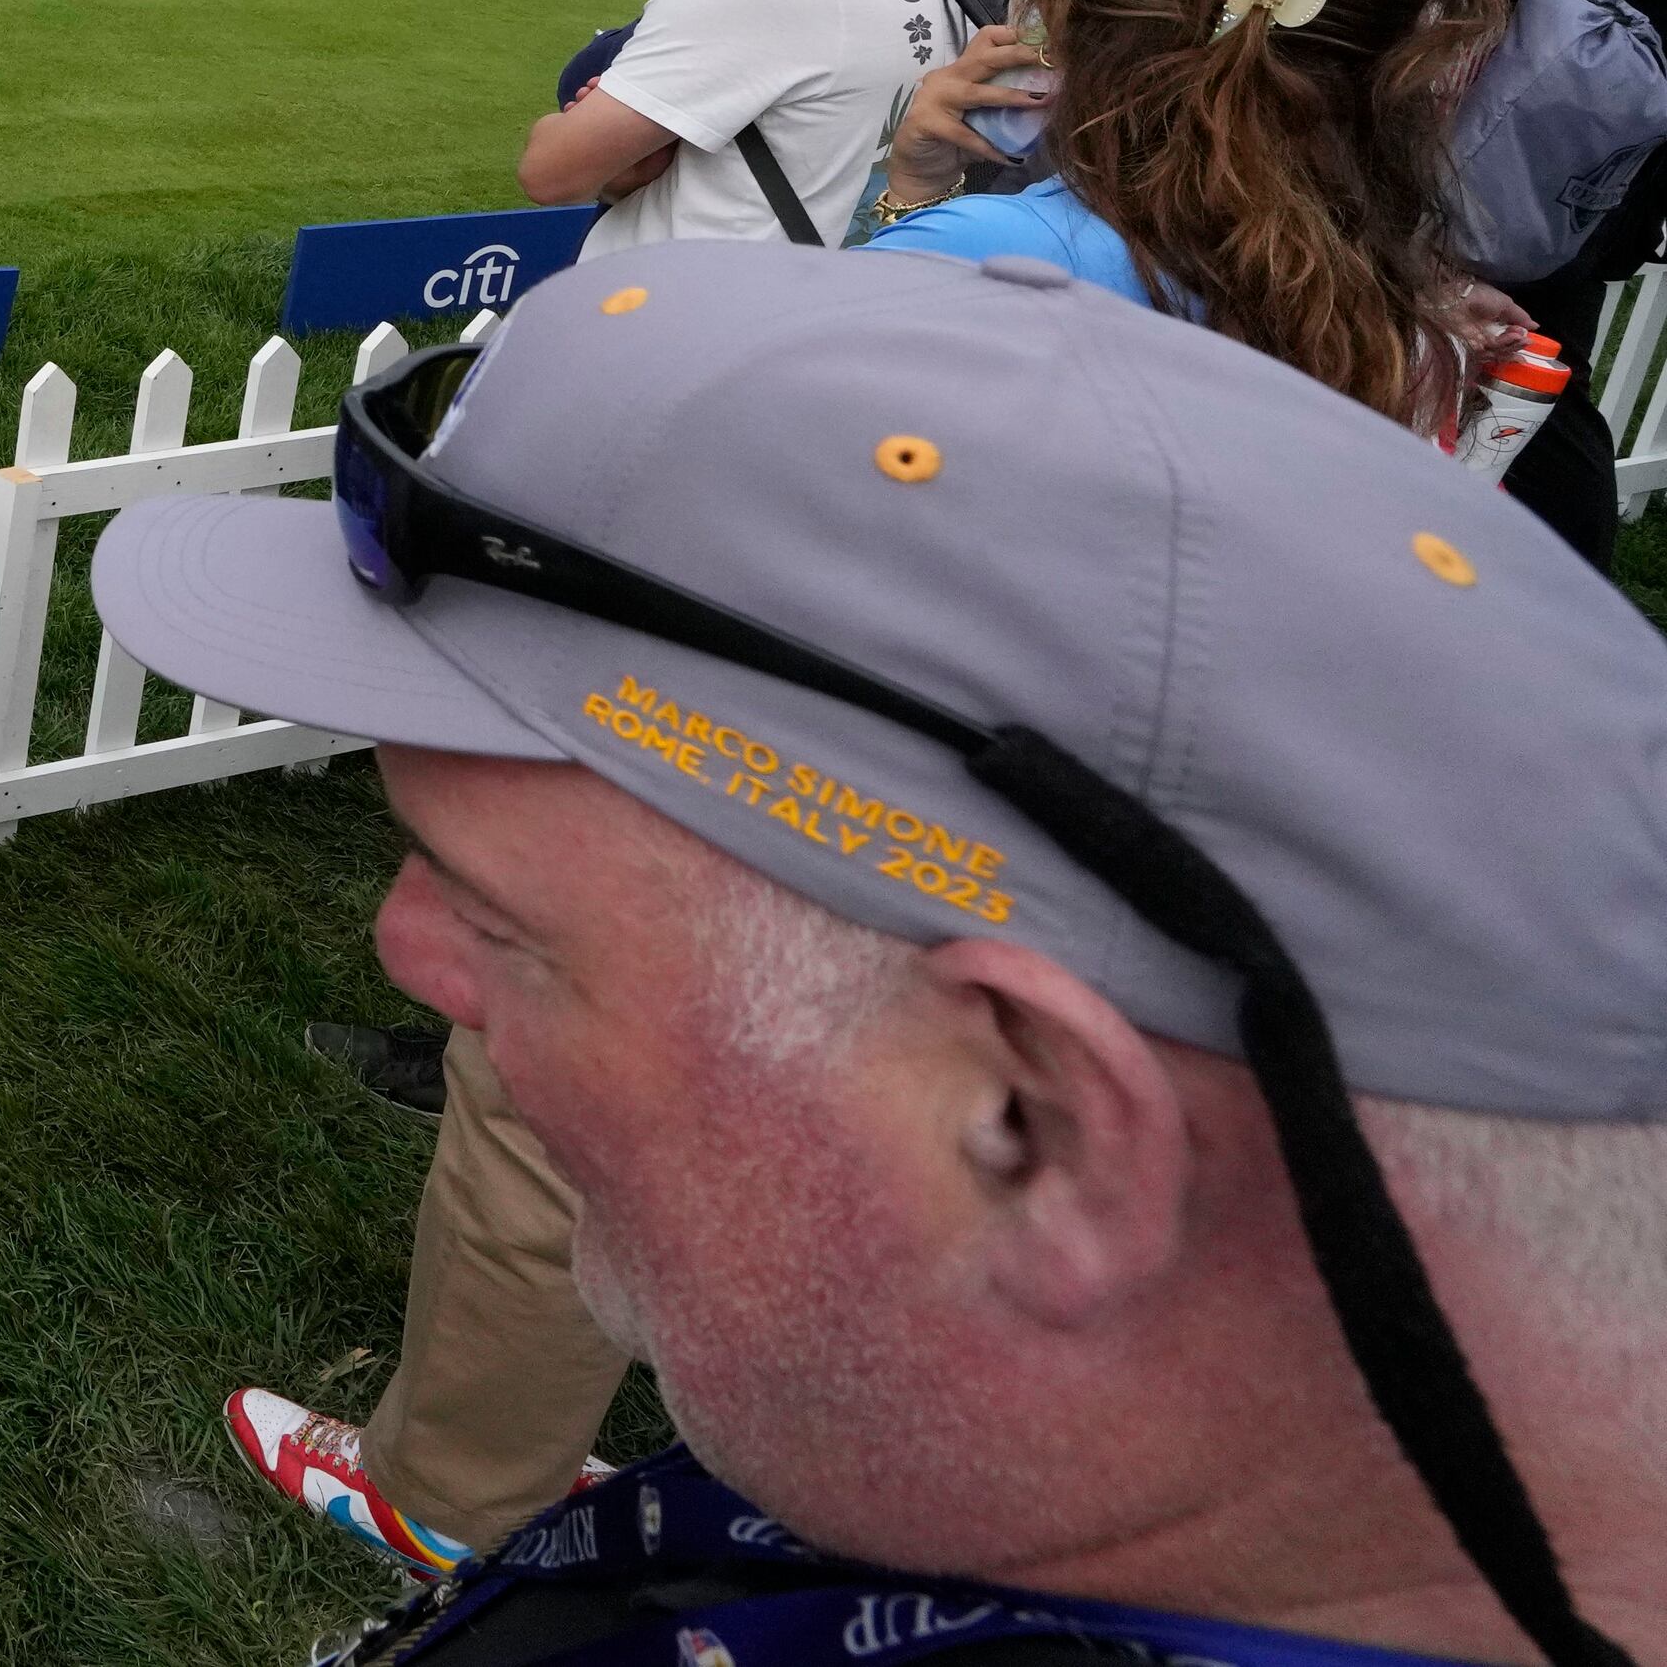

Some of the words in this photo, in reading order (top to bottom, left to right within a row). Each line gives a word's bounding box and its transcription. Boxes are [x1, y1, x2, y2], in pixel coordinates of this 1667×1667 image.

[423, 244, 520, 309] citi
[582, 691, 711, 786] ROME,
[725, 771, 871, 856] ITALY
[877, 847, 1016, 925] 2023
[615, 674, 780, 775] MARCO
[785, 763, 1007, 880] SIMONE
